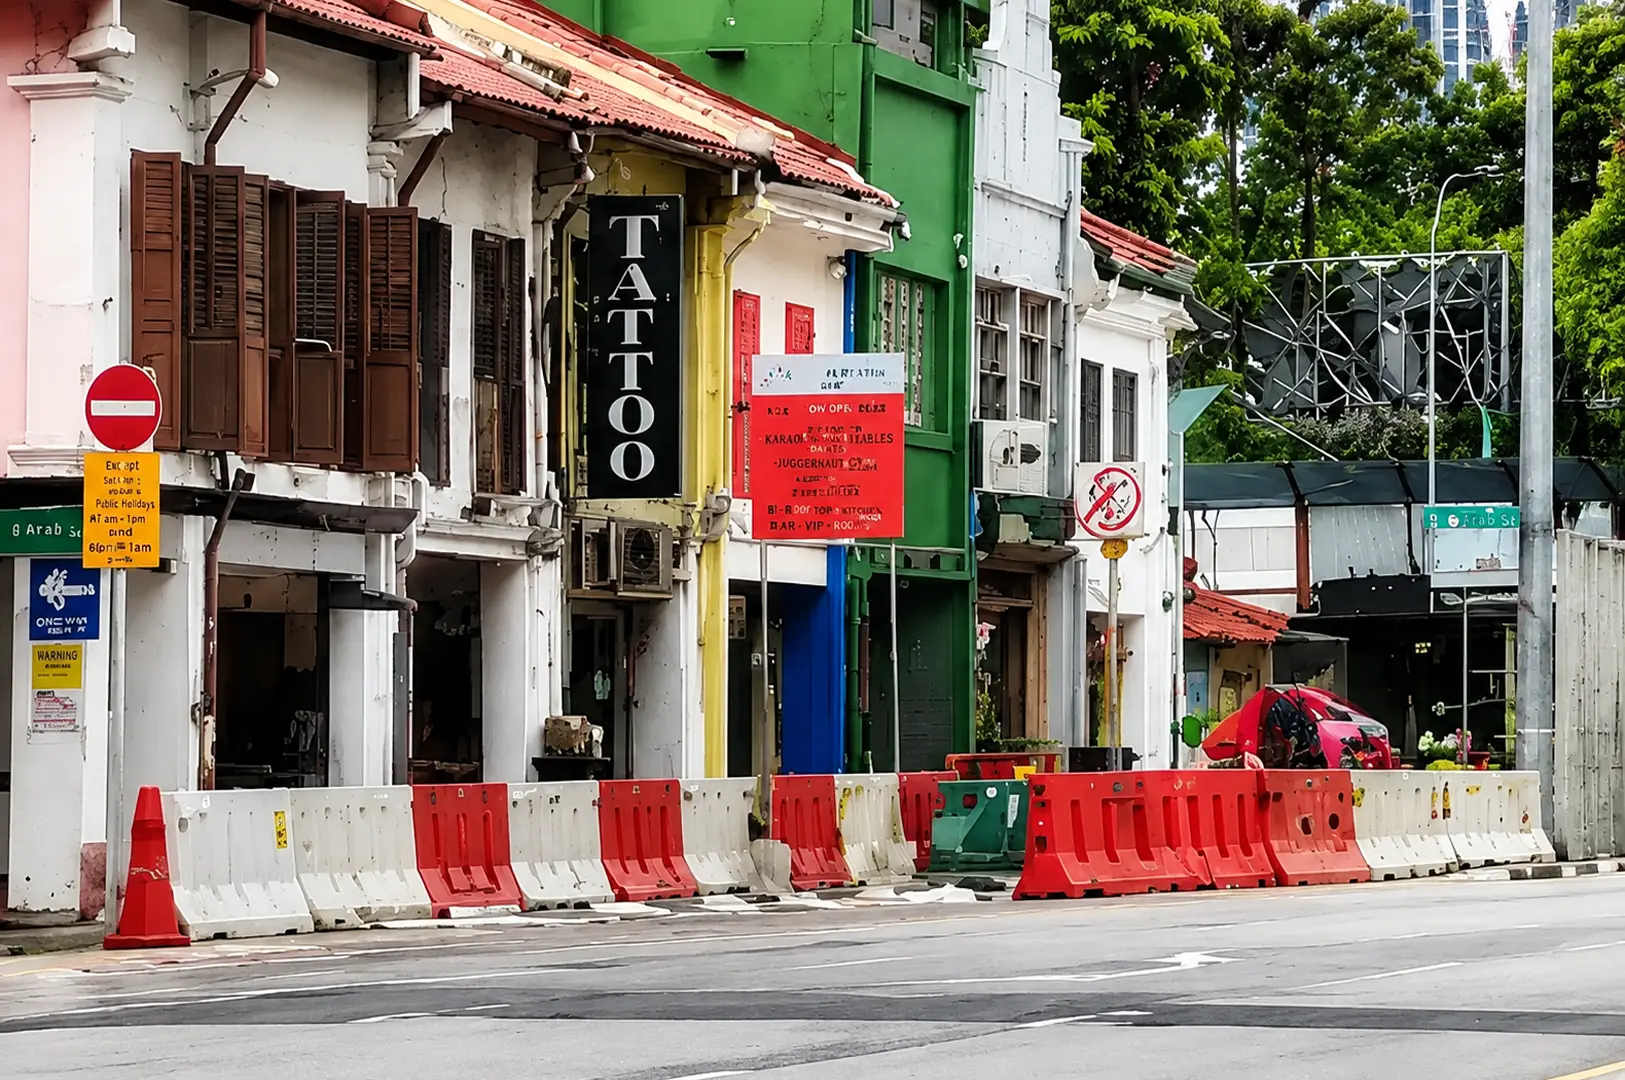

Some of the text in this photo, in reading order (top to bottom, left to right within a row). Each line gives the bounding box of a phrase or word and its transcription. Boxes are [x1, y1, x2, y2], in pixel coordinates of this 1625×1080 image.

[607, 215, 660, 481] TATTOO
[805, 521, 824, 530] VIP
[1463, 513, 1496, 527] Arab
[26, 523, 62, 535] Arab
[37, 650, 78, 661] WARNING
